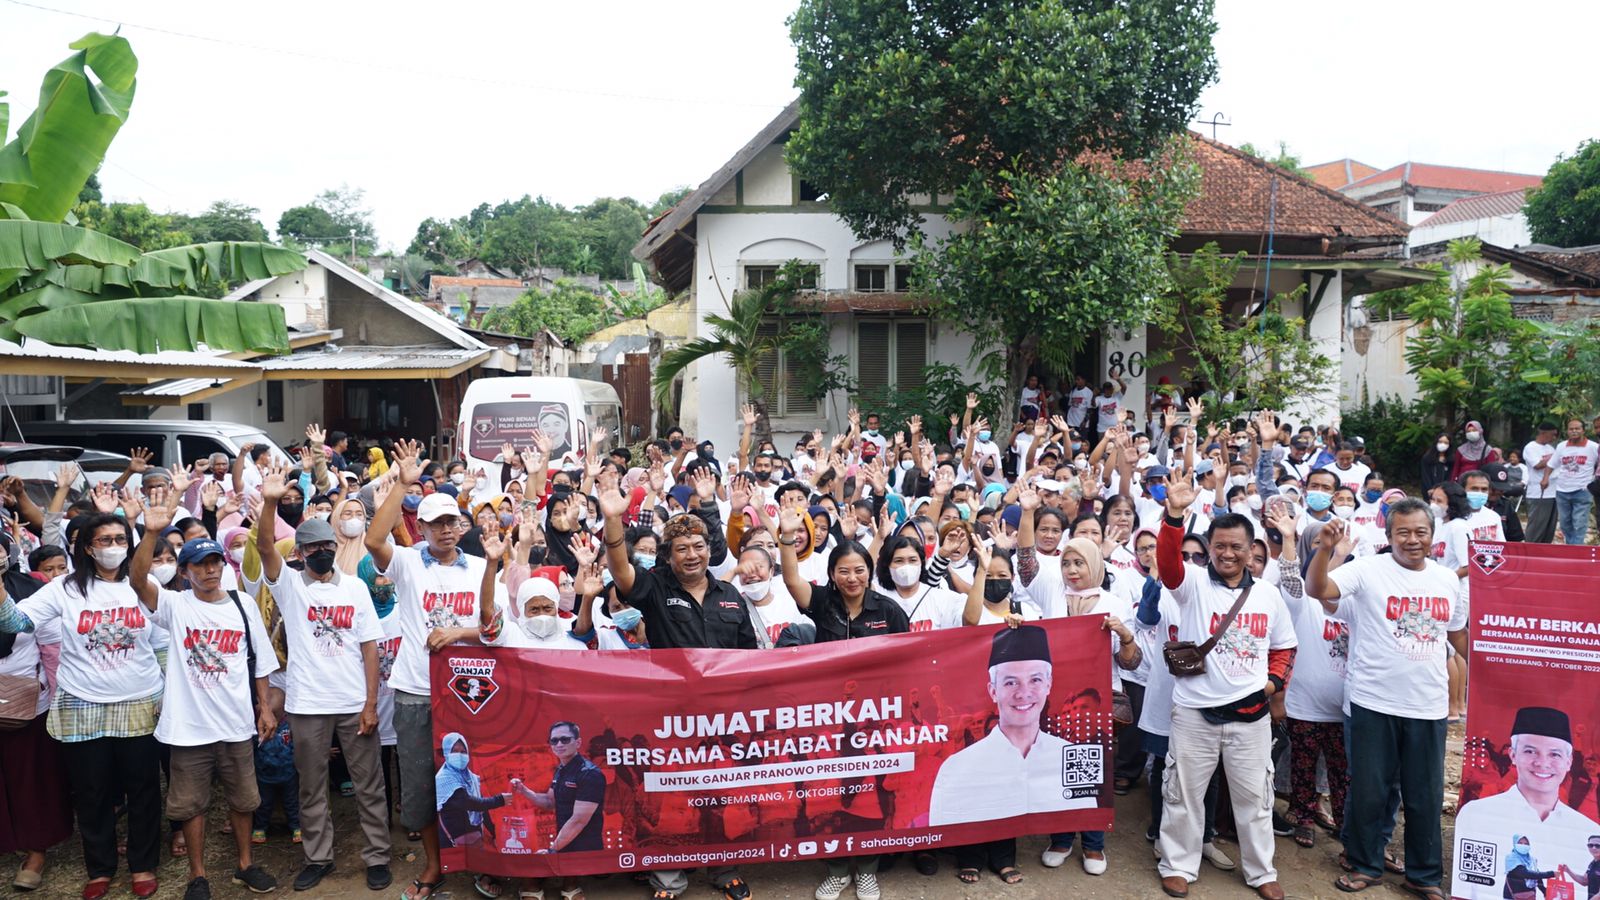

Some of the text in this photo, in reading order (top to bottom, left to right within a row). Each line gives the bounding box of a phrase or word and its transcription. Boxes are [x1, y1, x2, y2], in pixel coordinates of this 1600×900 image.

[1108, 351, 1145, 378] 80
[1479, 614, 1600, 635] JUMAT BERKA
[1481, 629, 1600, 647] BERSAMA SAHABAT GANJA
[1475, 642, 1497, 650] UNTUK
[1498, 644, 1525, 652] GANJAR
[1526, 647, 1561, 656] PRANOWO
[1562, 650, 1594, 659] PRESIDEN
[454, 667, 491, 675] GANJAR
[1550, 662, 1582, 671] OKTOBER
[653, 696, 903, 739] JUMAT BERKAH
[606, 725, 949, 766] BERSAMA SAHABAT GANJAR
[659, 758, 900, 786] UNTUK GANJAR PRANOWO PRESIDEN 2024
[687, 783, 874, 807] KOTA SEMARANG, 7 OKTOBER 2022
[1073, 789, 1089, 797] SCAN
[860, 832, 943, 849] sahabatganjar
[641, 847, 766, 866] @sahabatganjar2024
